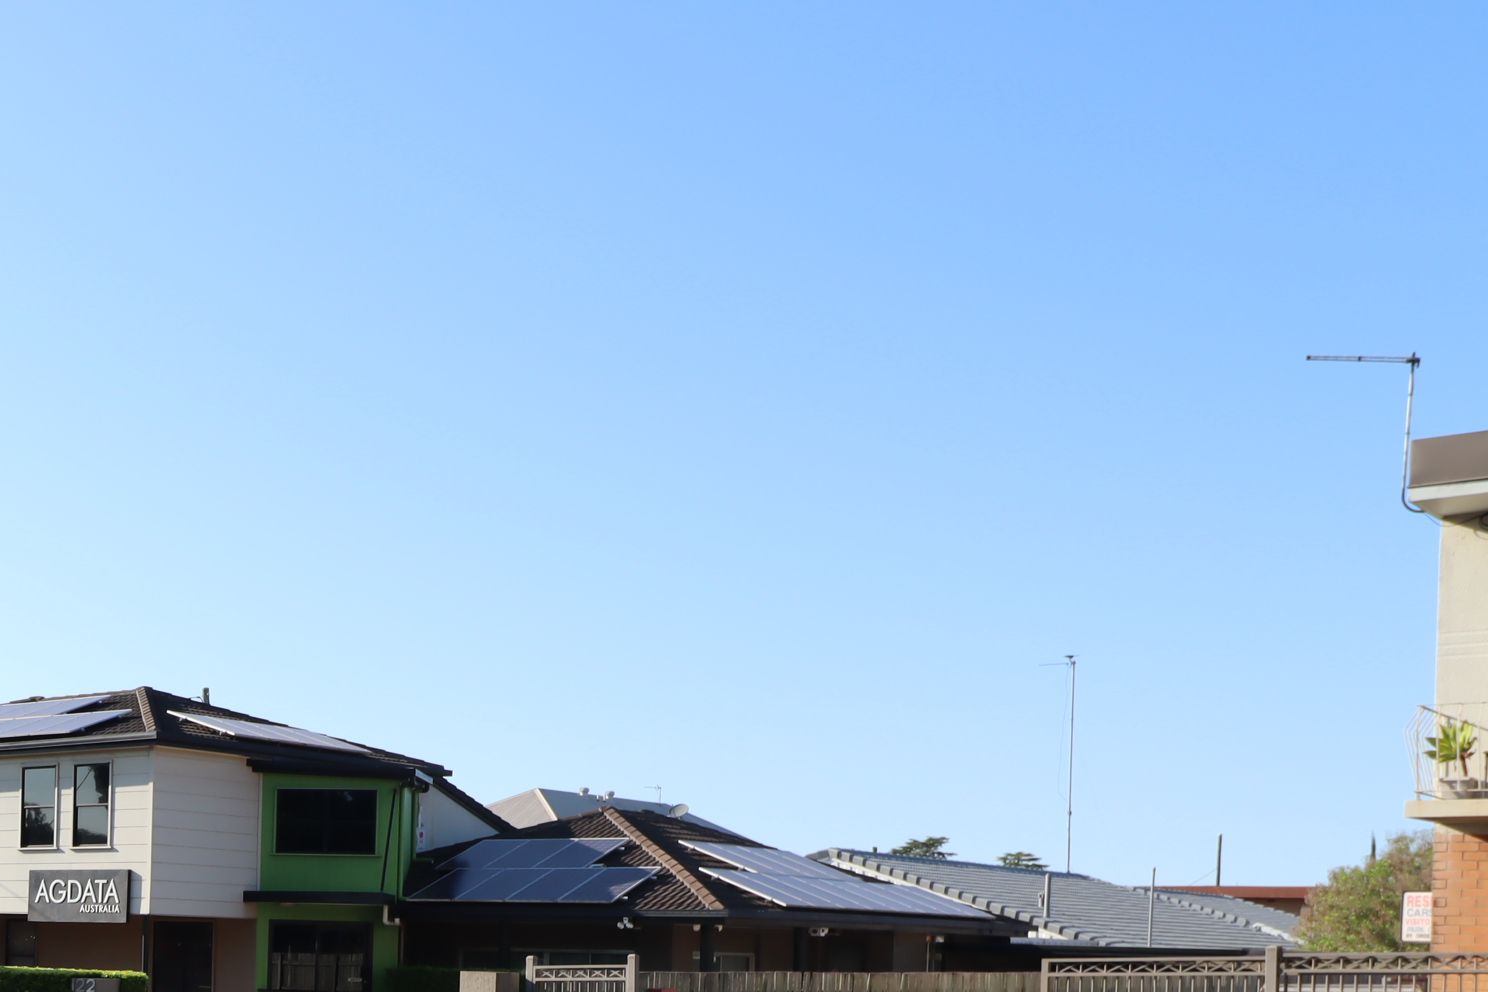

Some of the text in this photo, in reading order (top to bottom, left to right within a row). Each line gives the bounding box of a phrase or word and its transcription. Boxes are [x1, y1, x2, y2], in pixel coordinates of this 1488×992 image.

[34, 878, 120, 904] AGDATA
[1407, 895, 1432, 907] RES
[79, 904, 120, 913] AUSTRALIA
